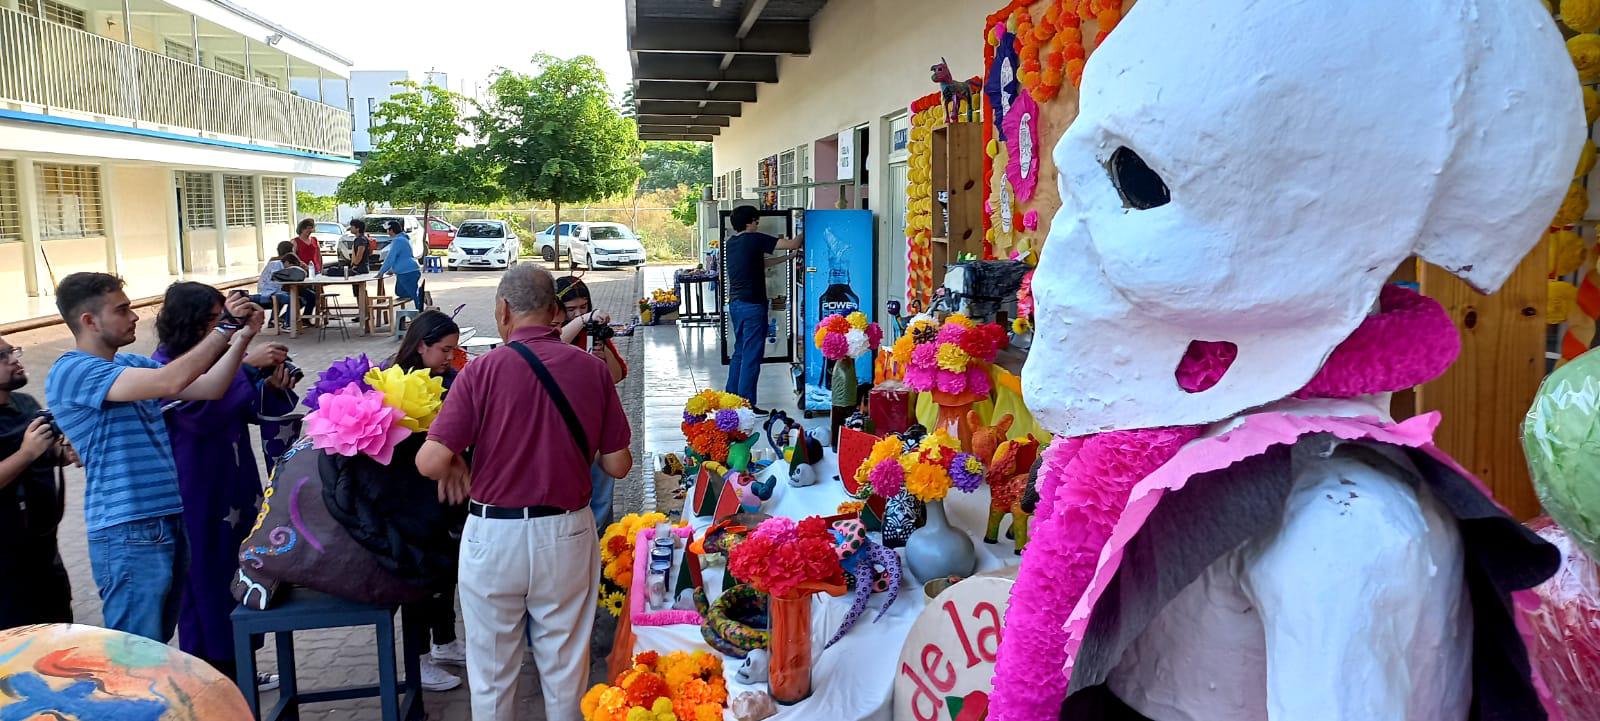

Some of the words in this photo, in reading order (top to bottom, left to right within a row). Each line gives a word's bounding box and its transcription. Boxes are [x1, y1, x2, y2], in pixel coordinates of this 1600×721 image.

[822, 301, 858, 310] POWER
[902, 643, 957, 721] de
[942, 600, 1003, 669] la
